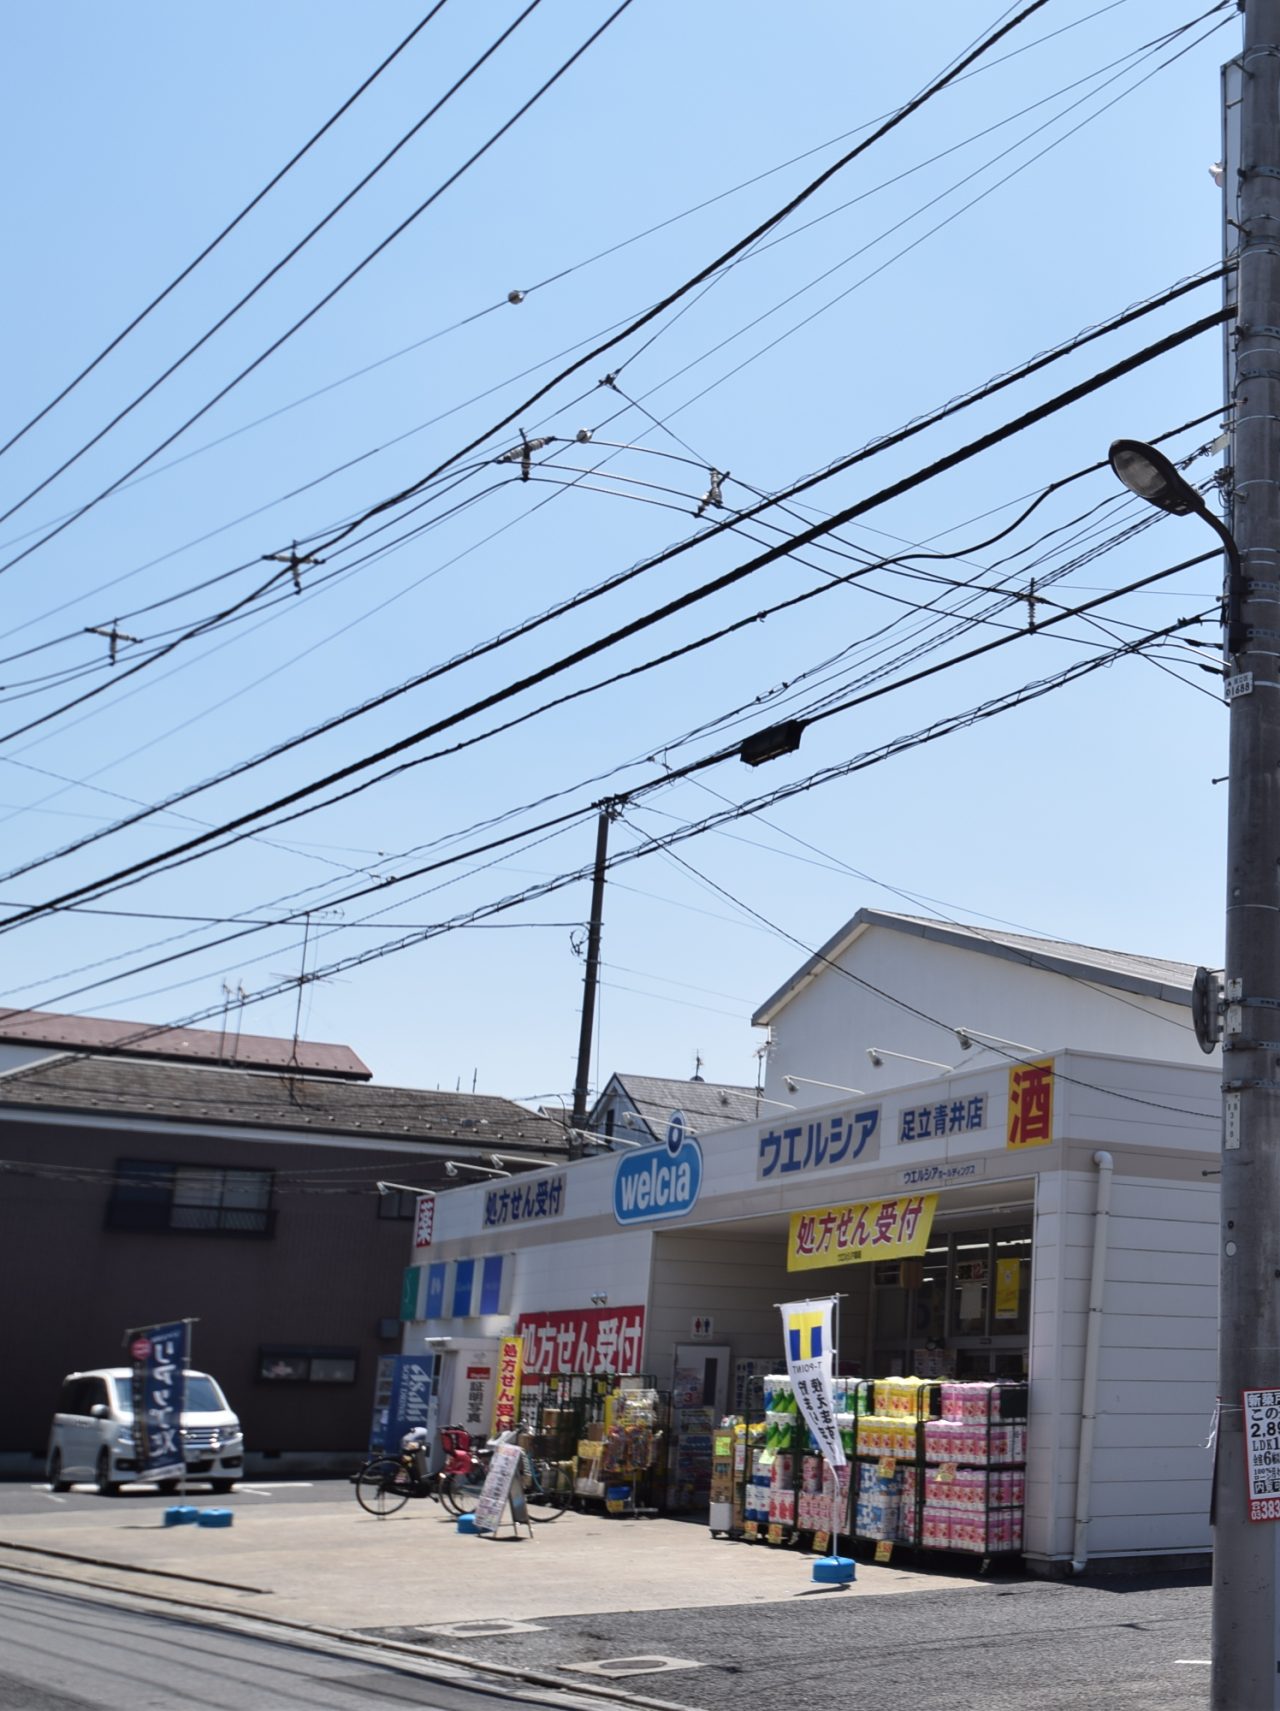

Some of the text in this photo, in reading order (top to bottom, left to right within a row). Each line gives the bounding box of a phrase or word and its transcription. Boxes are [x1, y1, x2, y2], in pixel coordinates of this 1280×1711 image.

[901, 1096, 984, 1142] 足立青井店
[1009, 1065, 1051, 1144] 酒
[759, 1109, 879, 1177] ウエルシア
[484, 1177, 563, 1226] 処方せん受付
[621, 1157, 691, 1212] welcia
[796, 1196, 925, 1255] 処方せん受付
[521, 1315, 642, 1375] 処方せん受付
[405, 1363, 432, 1422] Asahi
